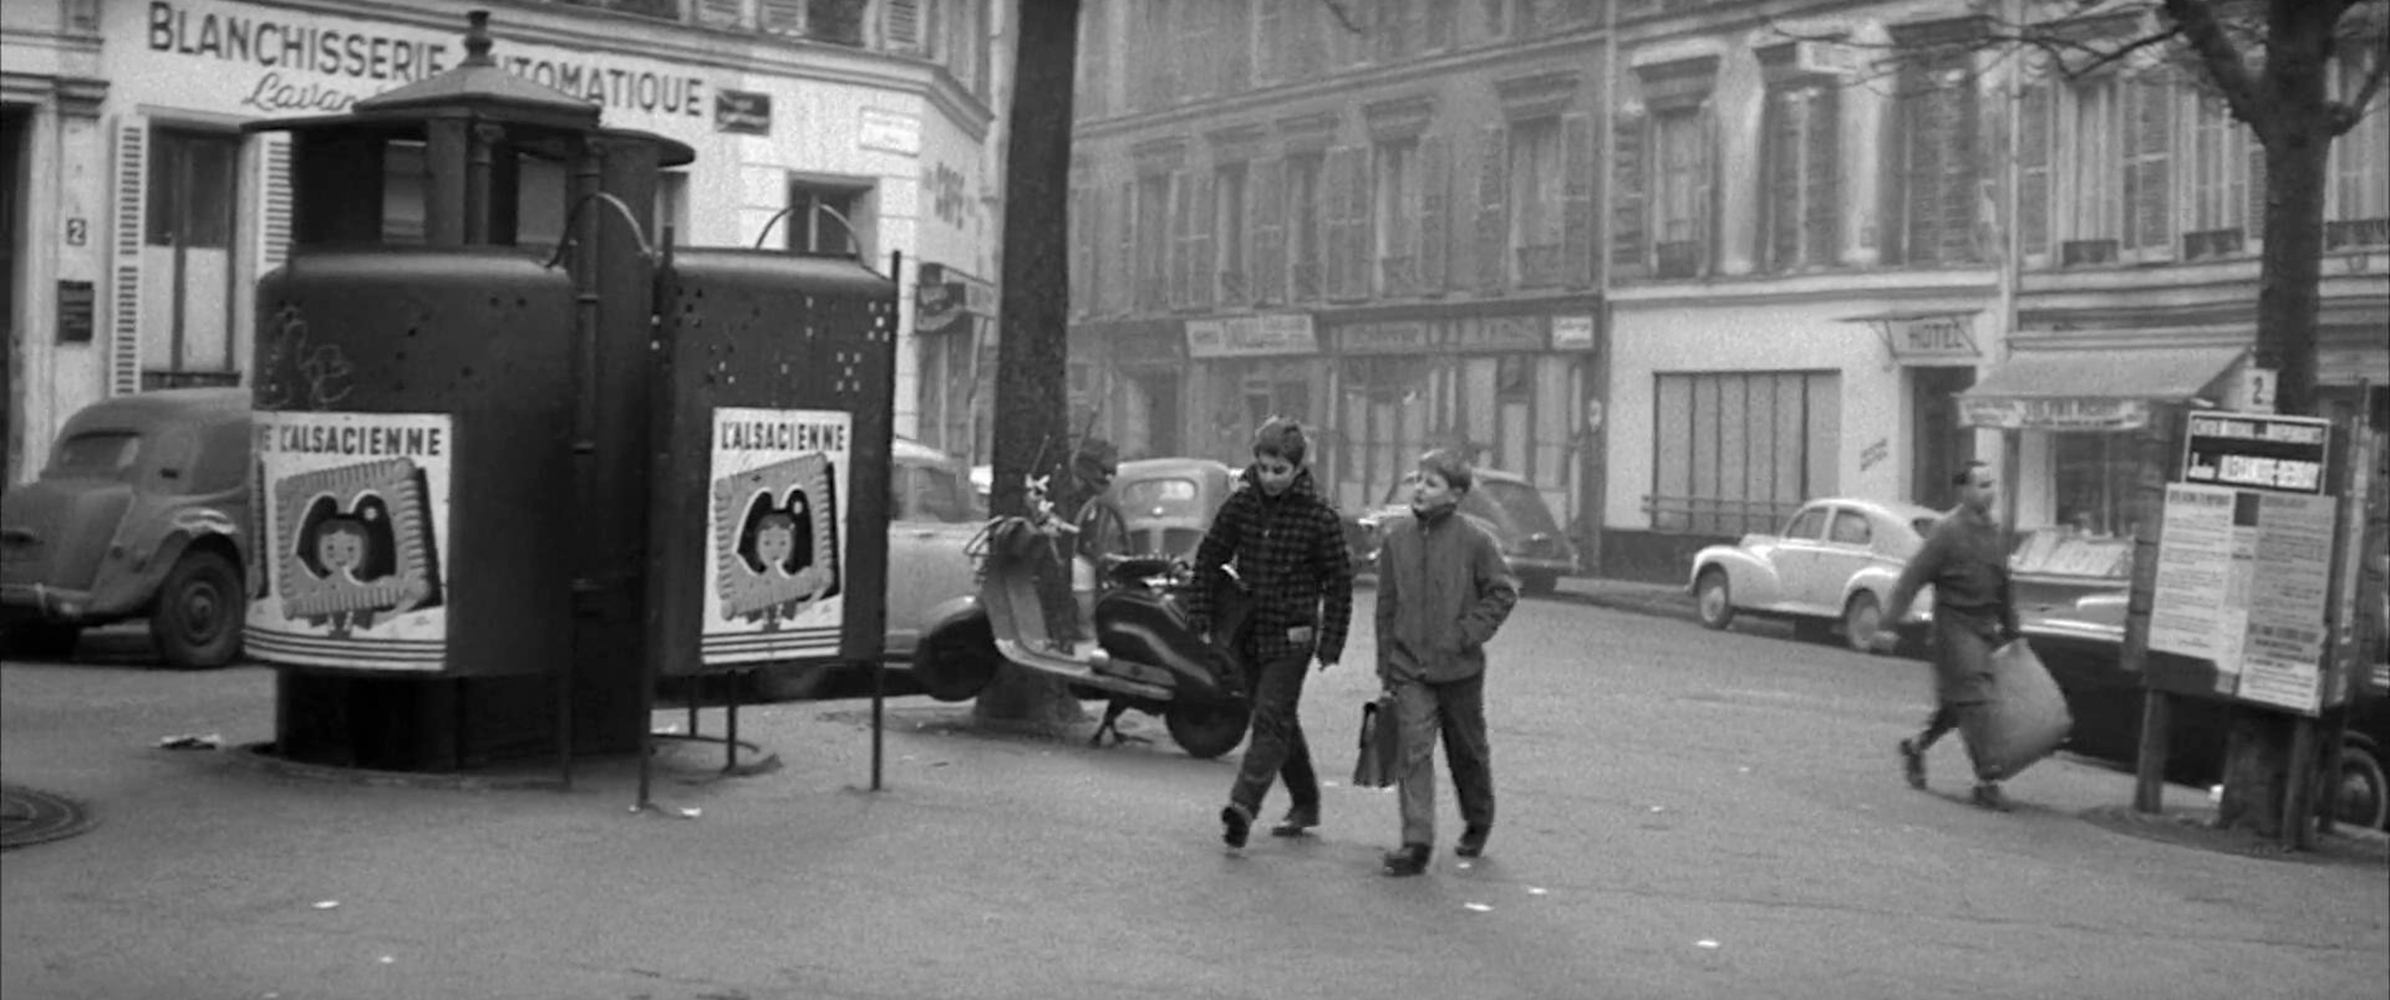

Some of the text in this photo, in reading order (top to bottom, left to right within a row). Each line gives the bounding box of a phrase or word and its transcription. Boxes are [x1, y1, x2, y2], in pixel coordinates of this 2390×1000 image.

[69, 220, 83, 244] 2
[1908, 323, 1963, 350] HOTEL
[280, 424, 441, 455] L'ALSACIENNE
[721, 422, 844, 451] L'ALSACIENNE
